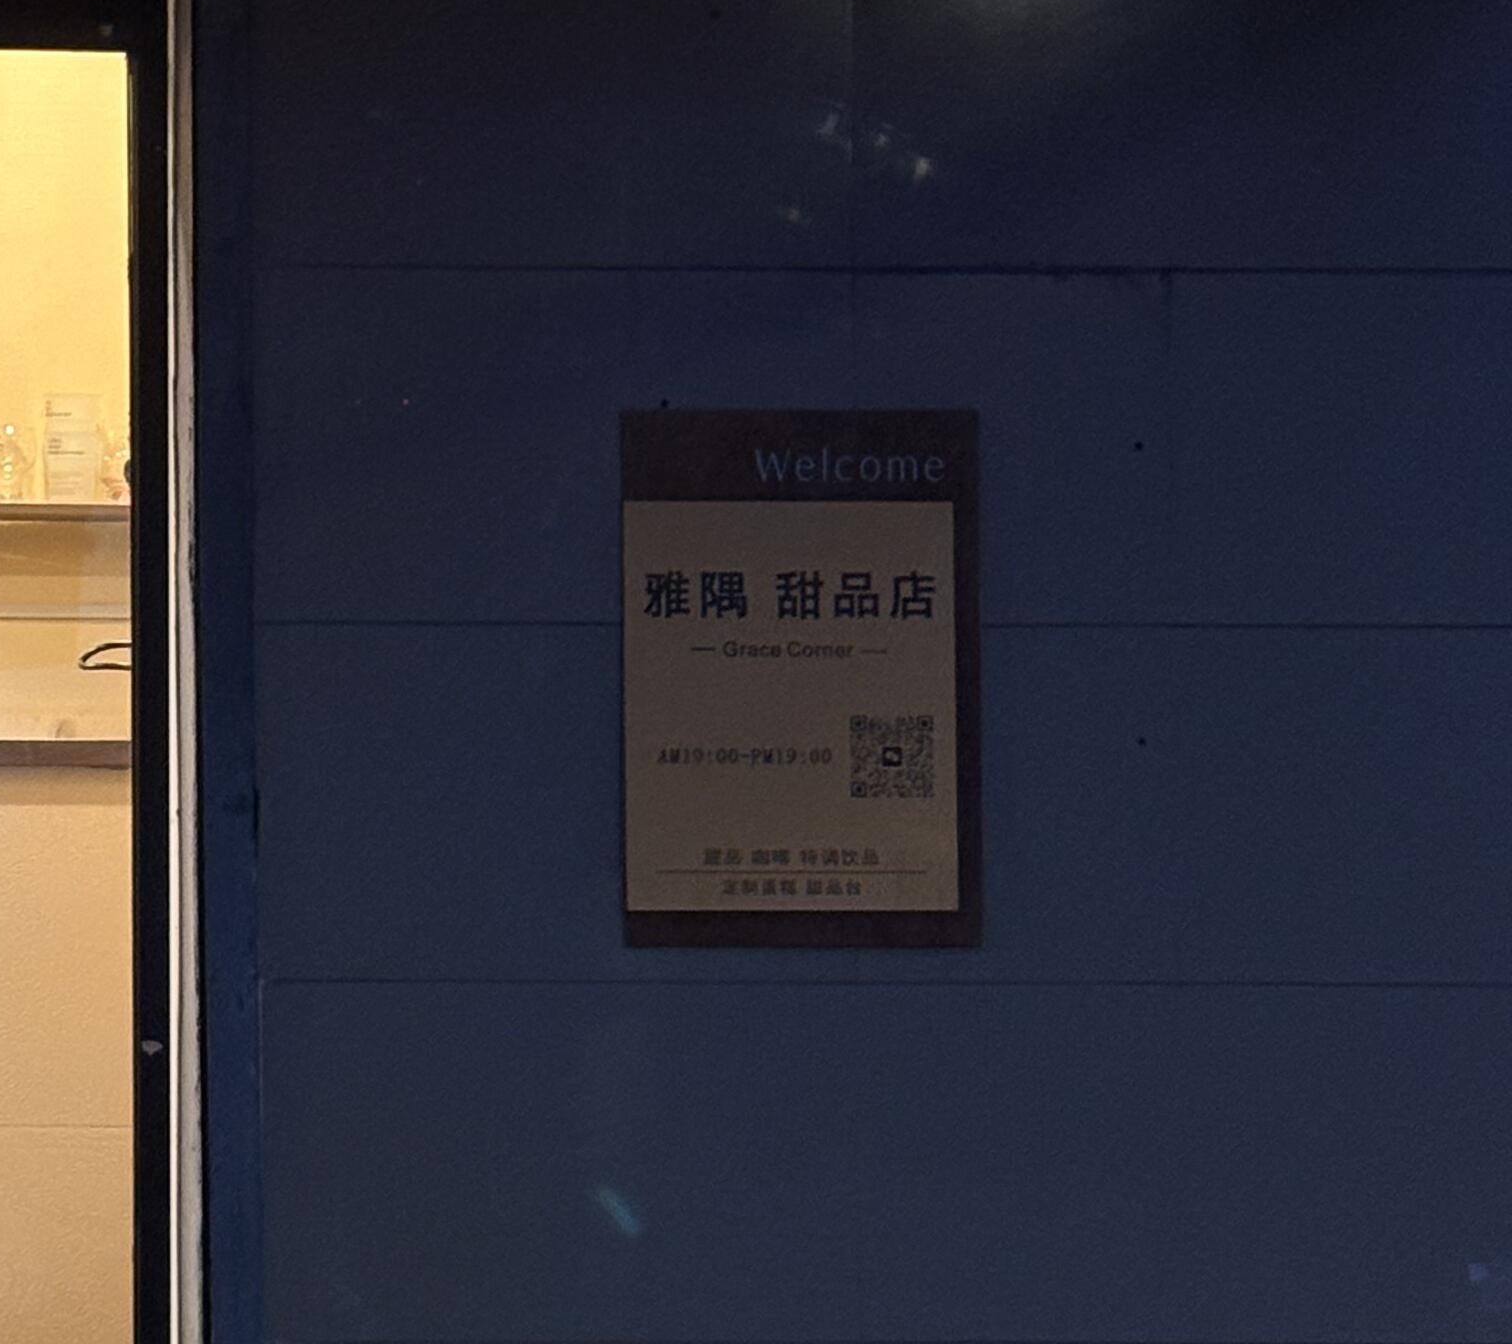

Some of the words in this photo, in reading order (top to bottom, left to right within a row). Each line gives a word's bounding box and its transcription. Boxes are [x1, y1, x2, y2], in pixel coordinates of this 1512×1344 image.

[753, 447, 946, 484] Welcome
[643, 570, 748, 620] 雅隅
[775, 570, 937, 621] 甜品店
[722, 640, 782, 659] Grace
[786, 640, 855, 659] Corner
